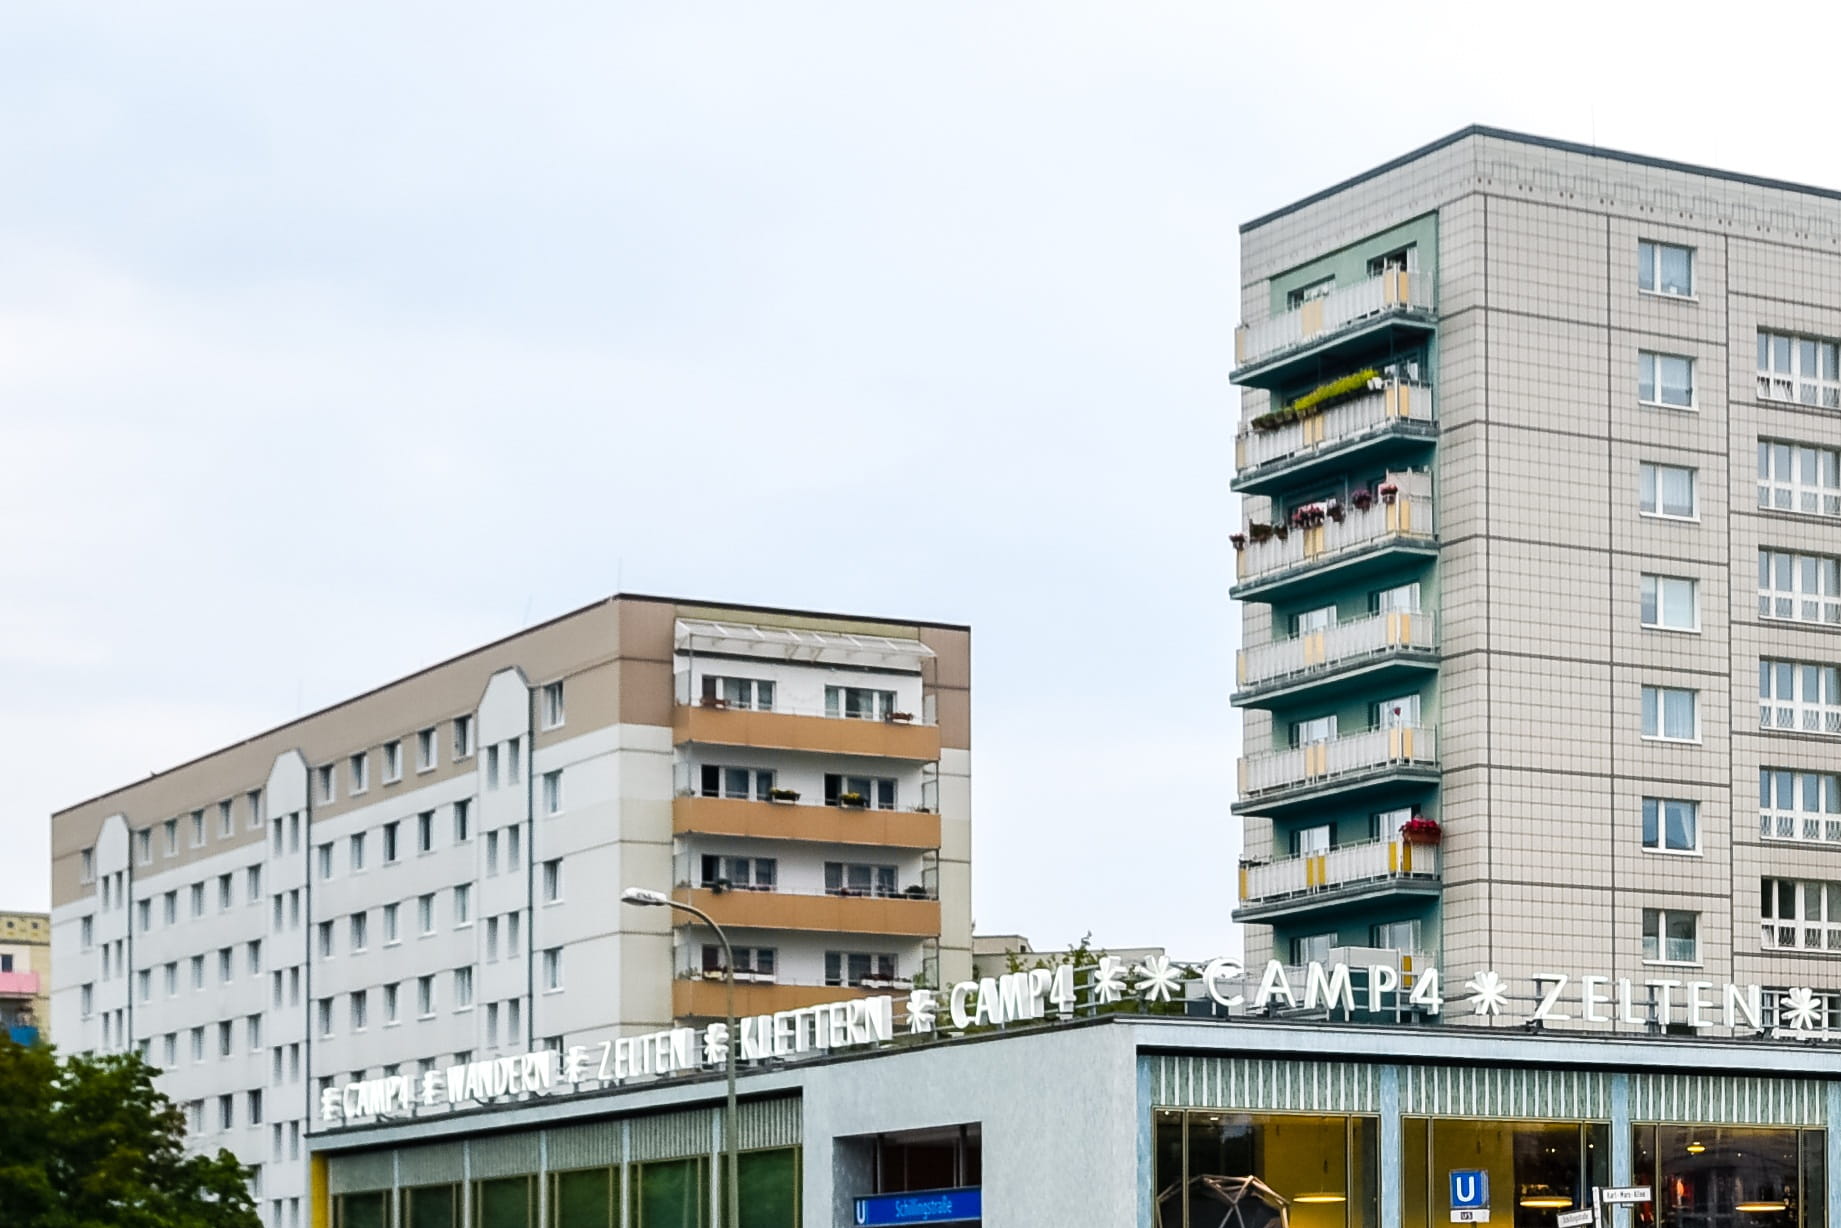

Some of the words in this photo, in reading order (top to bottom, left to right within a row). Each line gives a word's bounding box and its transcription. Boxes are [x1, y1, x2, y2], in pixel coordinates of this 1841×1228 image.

[1534, 973, 1761, 1029] ZELTEN
[448, 1050, 557, 1102] WANDERN
[598, 1027, 694, 1080] ZELTEN
[740, 996, 892, 1060] KLETTERN
[1456, 1175, 1475, 1202] U
